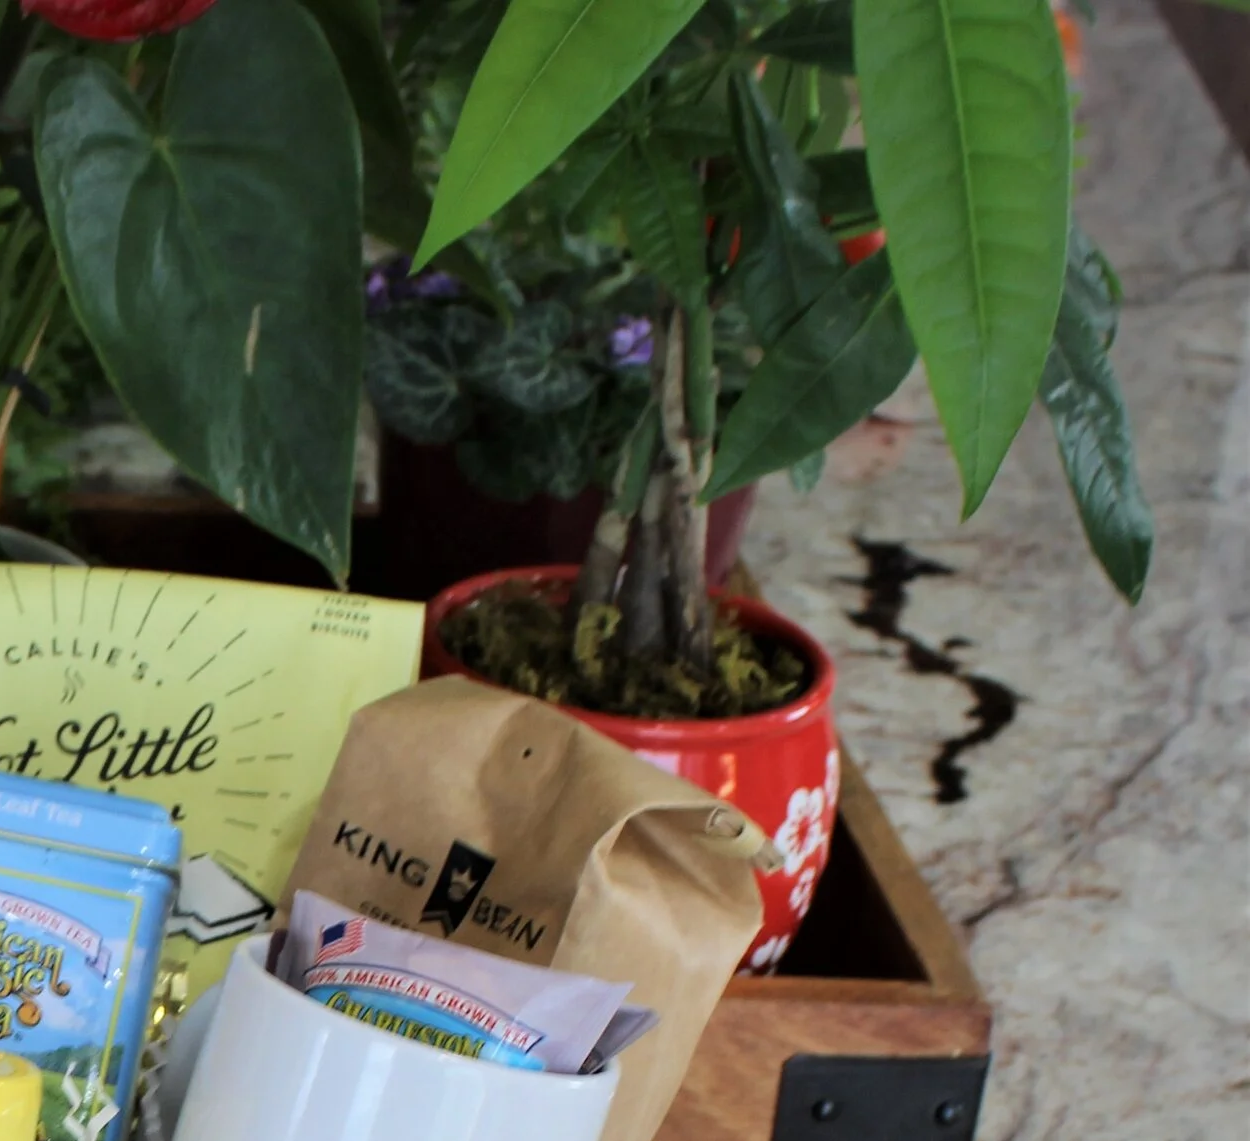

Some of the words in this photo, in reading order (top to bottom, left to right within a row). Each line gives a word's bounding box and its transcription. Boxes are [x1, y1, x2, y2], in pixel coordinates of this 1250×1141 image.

[4, 637, 149, 680] CALLIE'S
[55, 702, 219, 783] Little
[44, 804, 82, 826] Tea
[333, 821, 430, 888] KING
[472, 898, 545, 951] BEAN
[1, 900, 61, 931] GROWN
[66, 926, 96, 950] TEA
[326, 991, 485, 1058] CHARLESTON
[344, 969, 431, 999] AMERICAN
[436, 990, 498, 1033] GROWN
